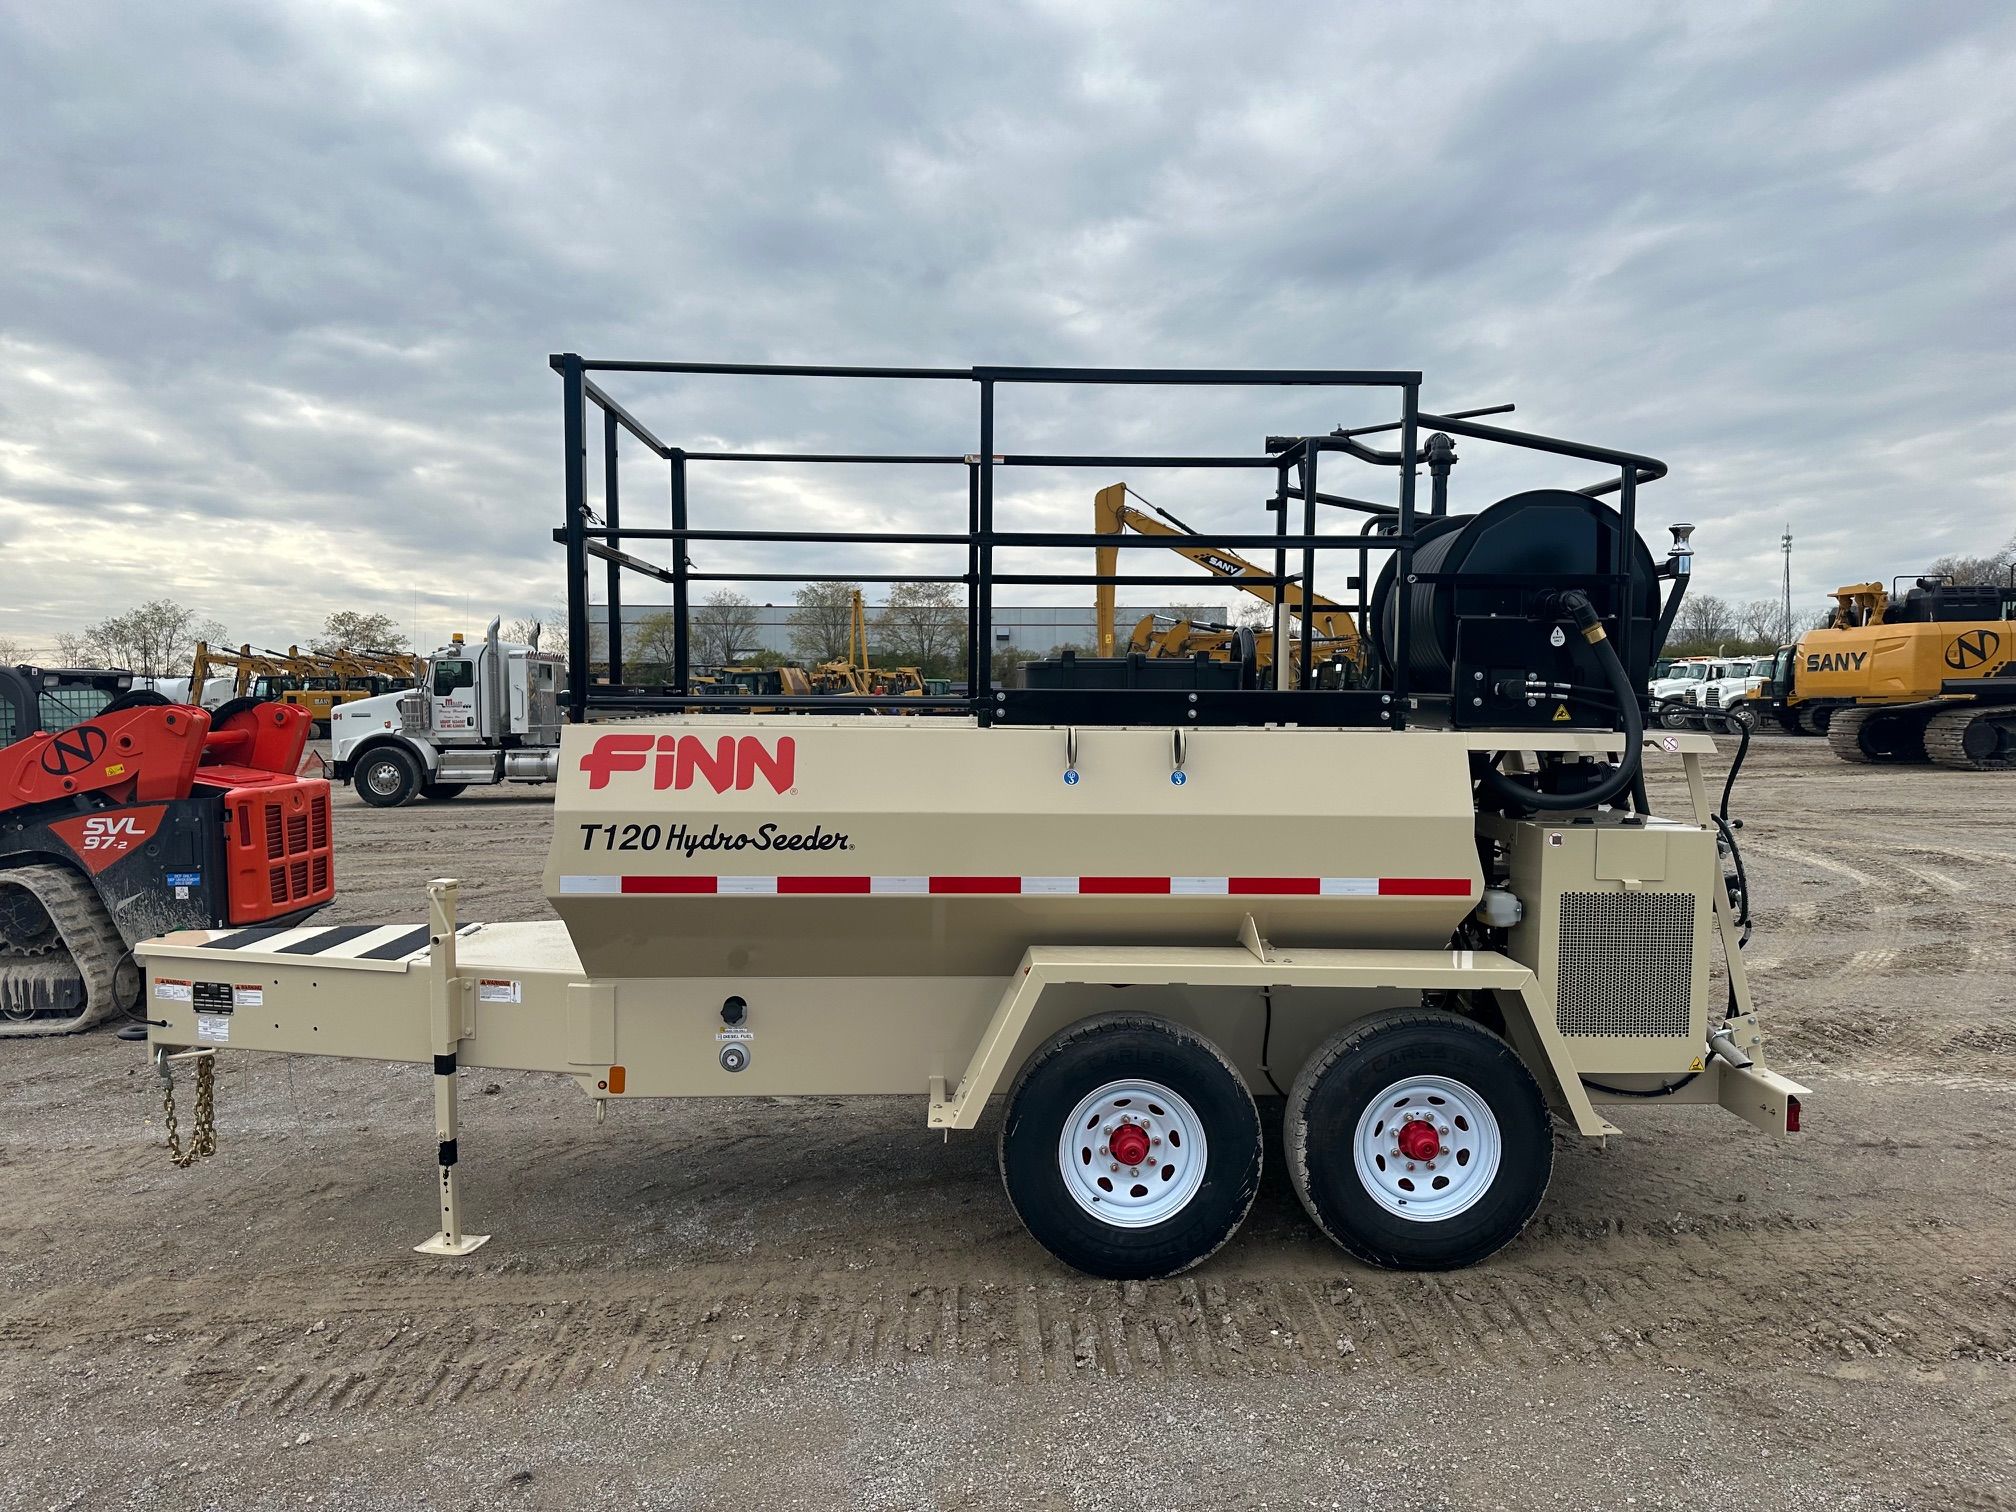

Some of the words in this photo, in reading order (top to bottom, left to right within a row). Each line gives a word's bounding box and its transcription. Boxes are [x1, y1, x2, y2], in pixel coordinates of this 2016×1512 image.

[1208, 556, 1238, 575] SANY
[1806, 651, 1868, 673] SANY
[579, 734, 796, 796] FINN
[83, 817, 146, 835] SVL
[83, 836, 128, 850] 97-2
[580, 824, 662, 851] T120
